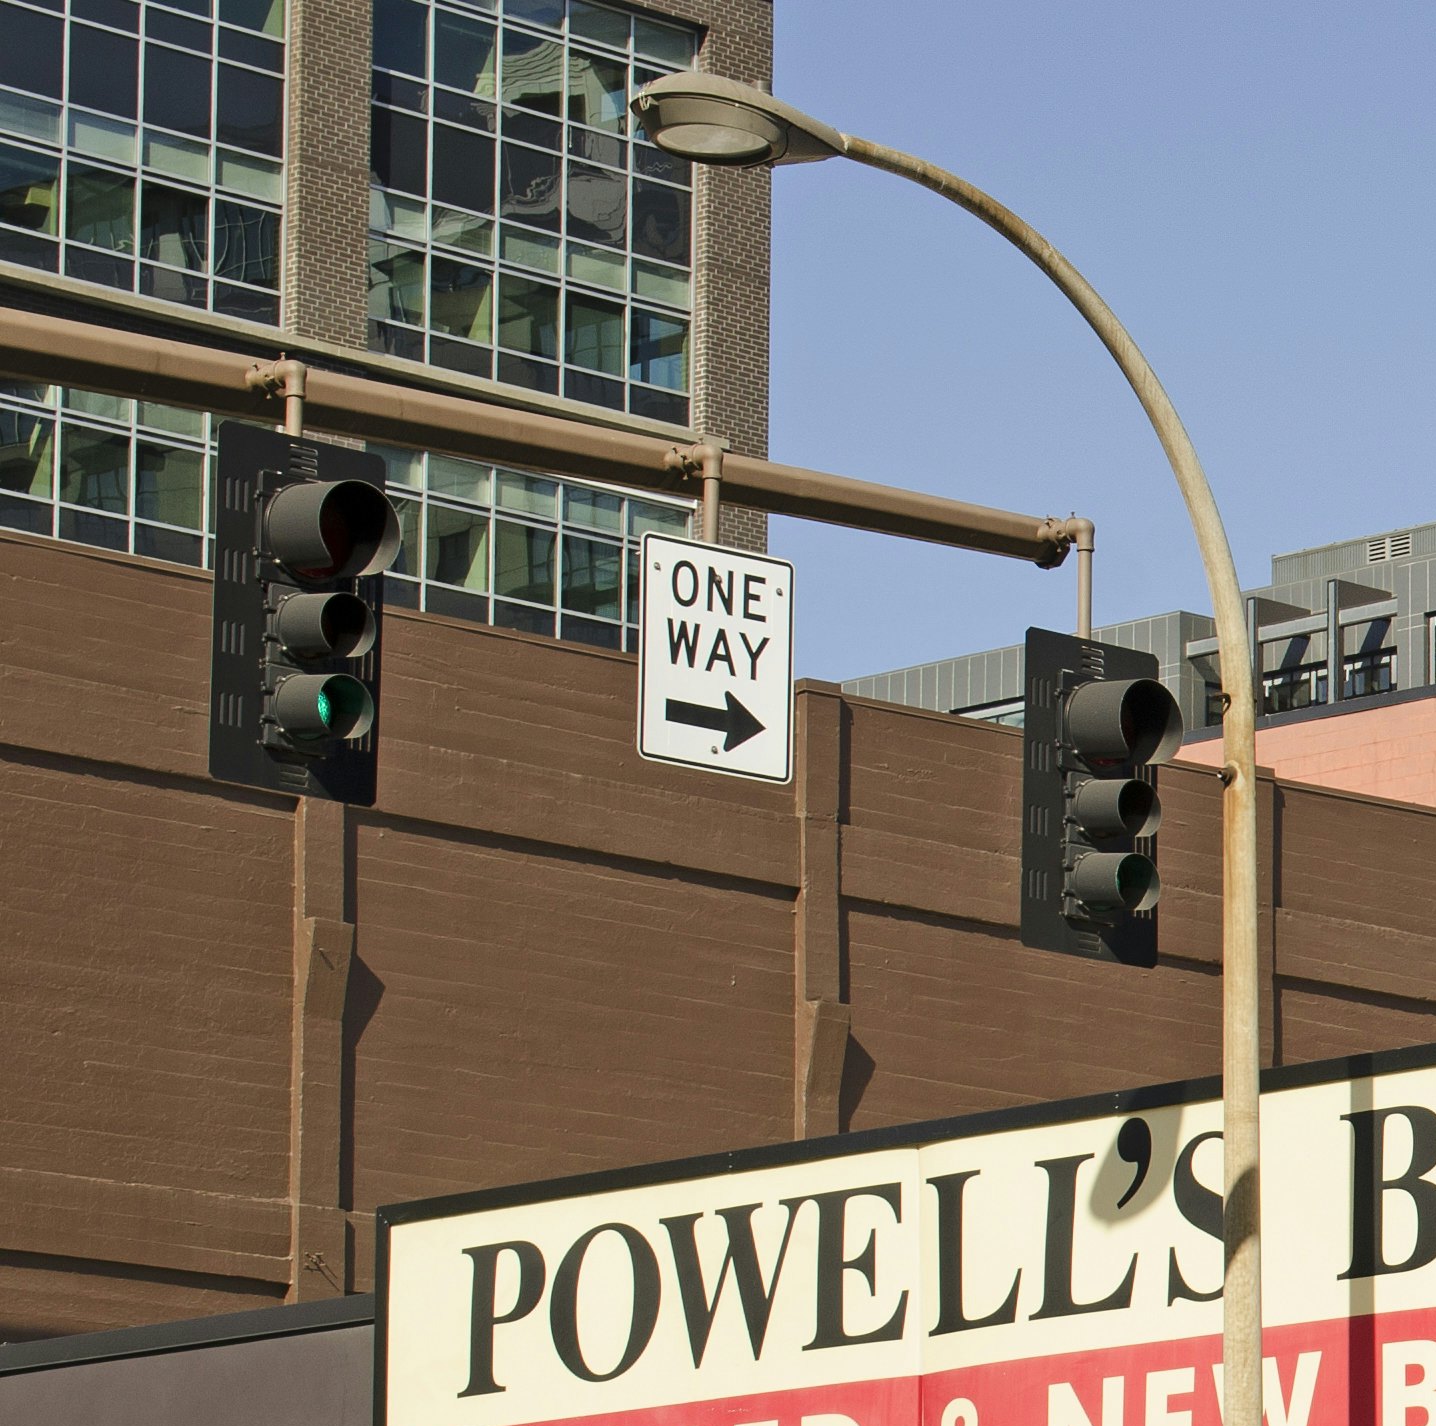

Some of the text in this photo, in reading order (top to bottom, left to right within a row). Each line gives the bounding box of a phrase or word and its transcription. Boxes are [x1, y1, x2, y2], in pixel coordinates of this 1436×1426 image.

[671, 559, 767, 624] ONE
[666, 617, 770, 681] WAY
[457, 1117, 1224, 1399] POWELL'S
